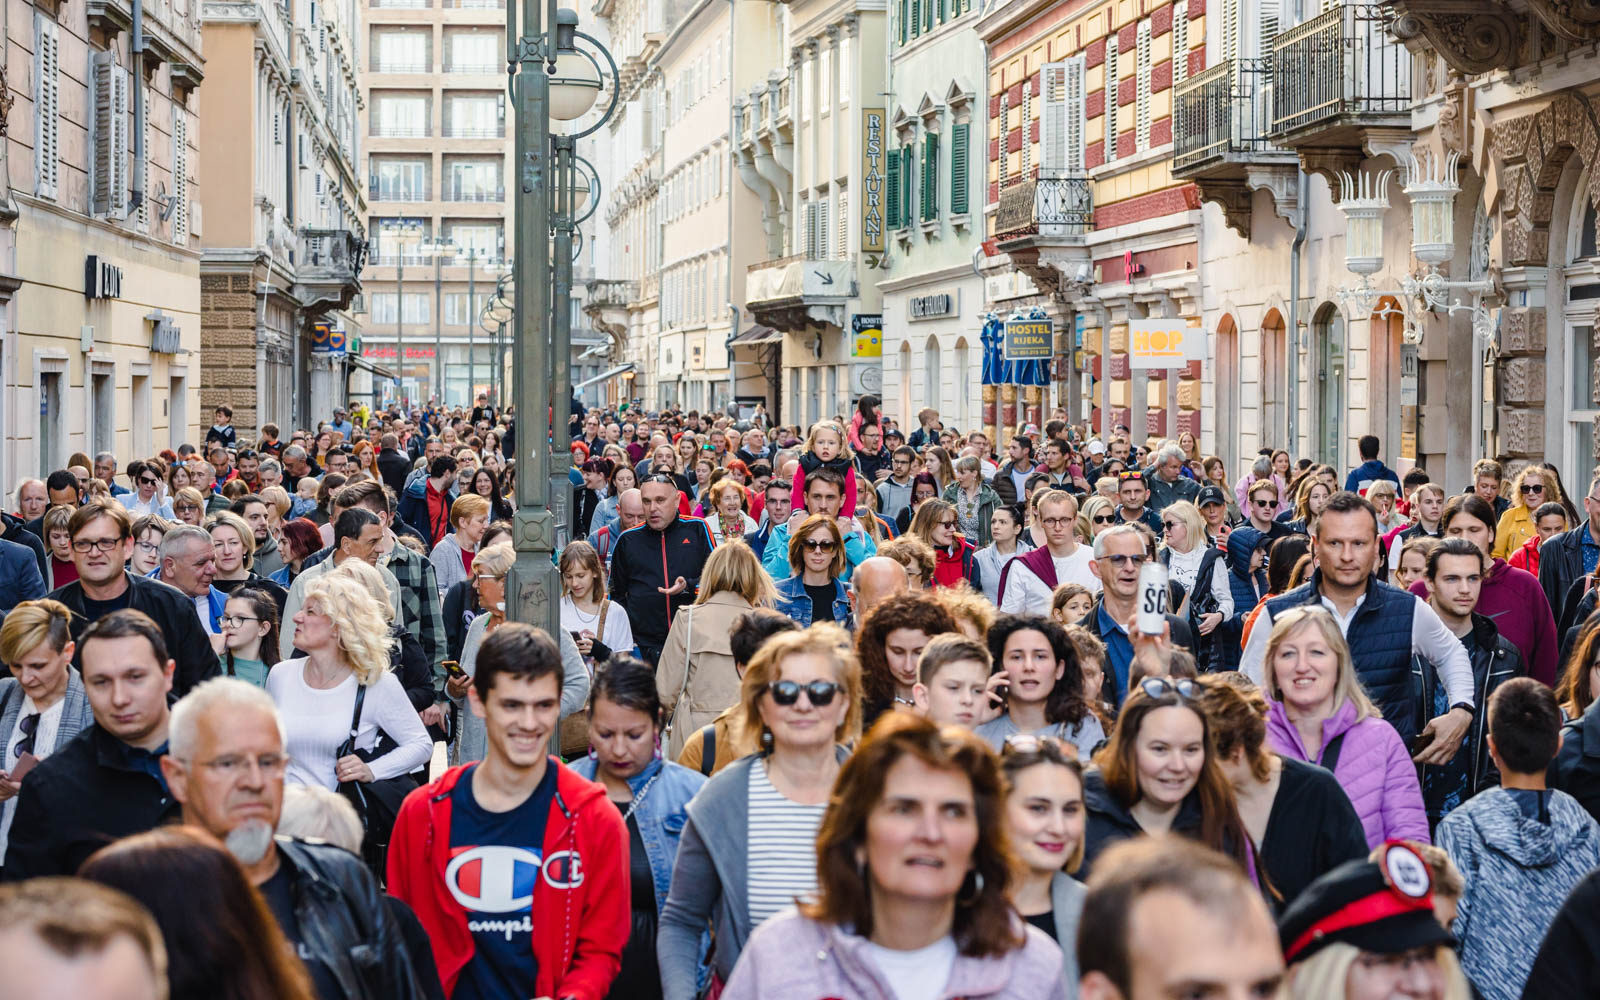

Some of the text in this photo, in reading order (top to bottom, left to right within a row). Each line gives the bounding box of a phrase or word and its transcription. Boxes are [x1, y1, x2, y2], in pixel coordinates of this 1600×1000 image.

[866, 114, 881, 246] RESTAURANT
[1007, 324, 1051, 335] HOSTEL
[1013, 336, 1045, 345] RIJEKA
[1134, 330, 1183, 351] HOP
[362, 347, 436, 358] Addik Bank
[468, 915, 534, 942] ampi
